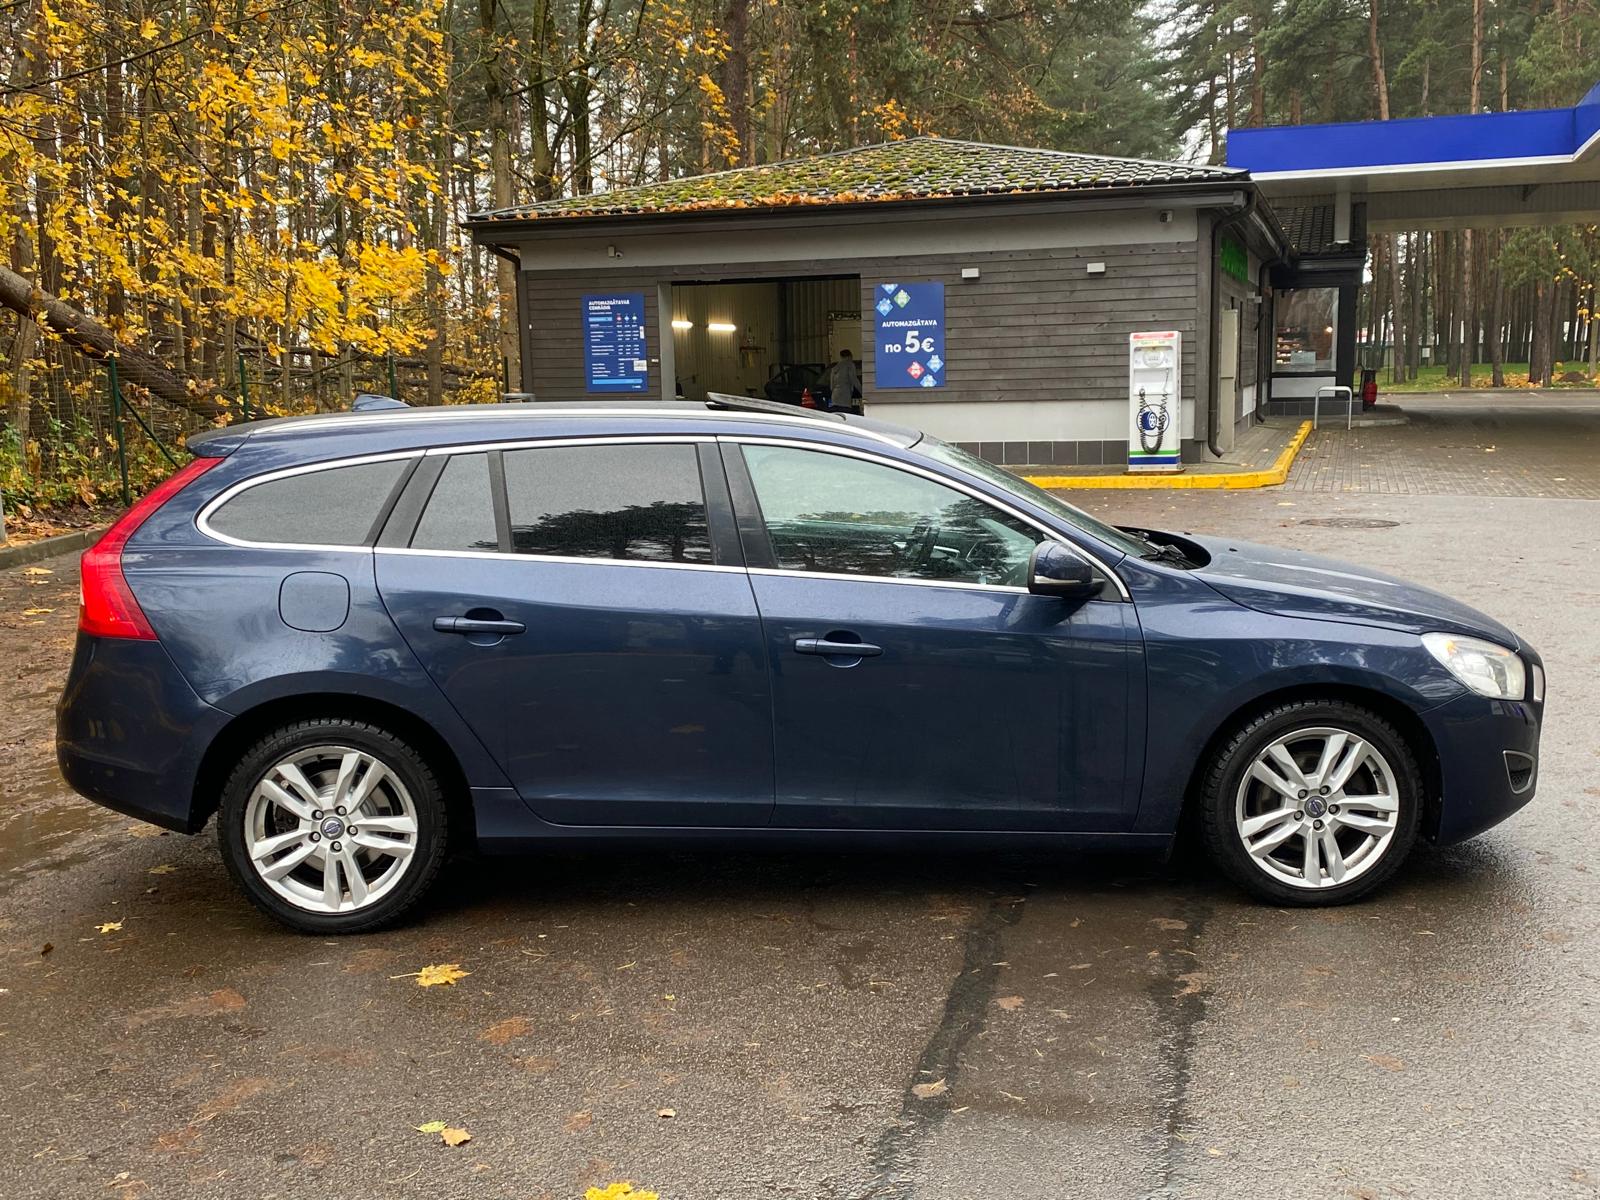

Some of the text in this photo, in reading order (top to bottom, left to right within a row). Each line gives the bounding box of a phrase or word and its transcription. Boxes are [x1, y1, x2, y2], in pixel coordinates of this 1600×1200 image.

[882, 319, 937, 328] AUTOMAZGĀTAVA
[885, 330, 935, 353] no 5€
